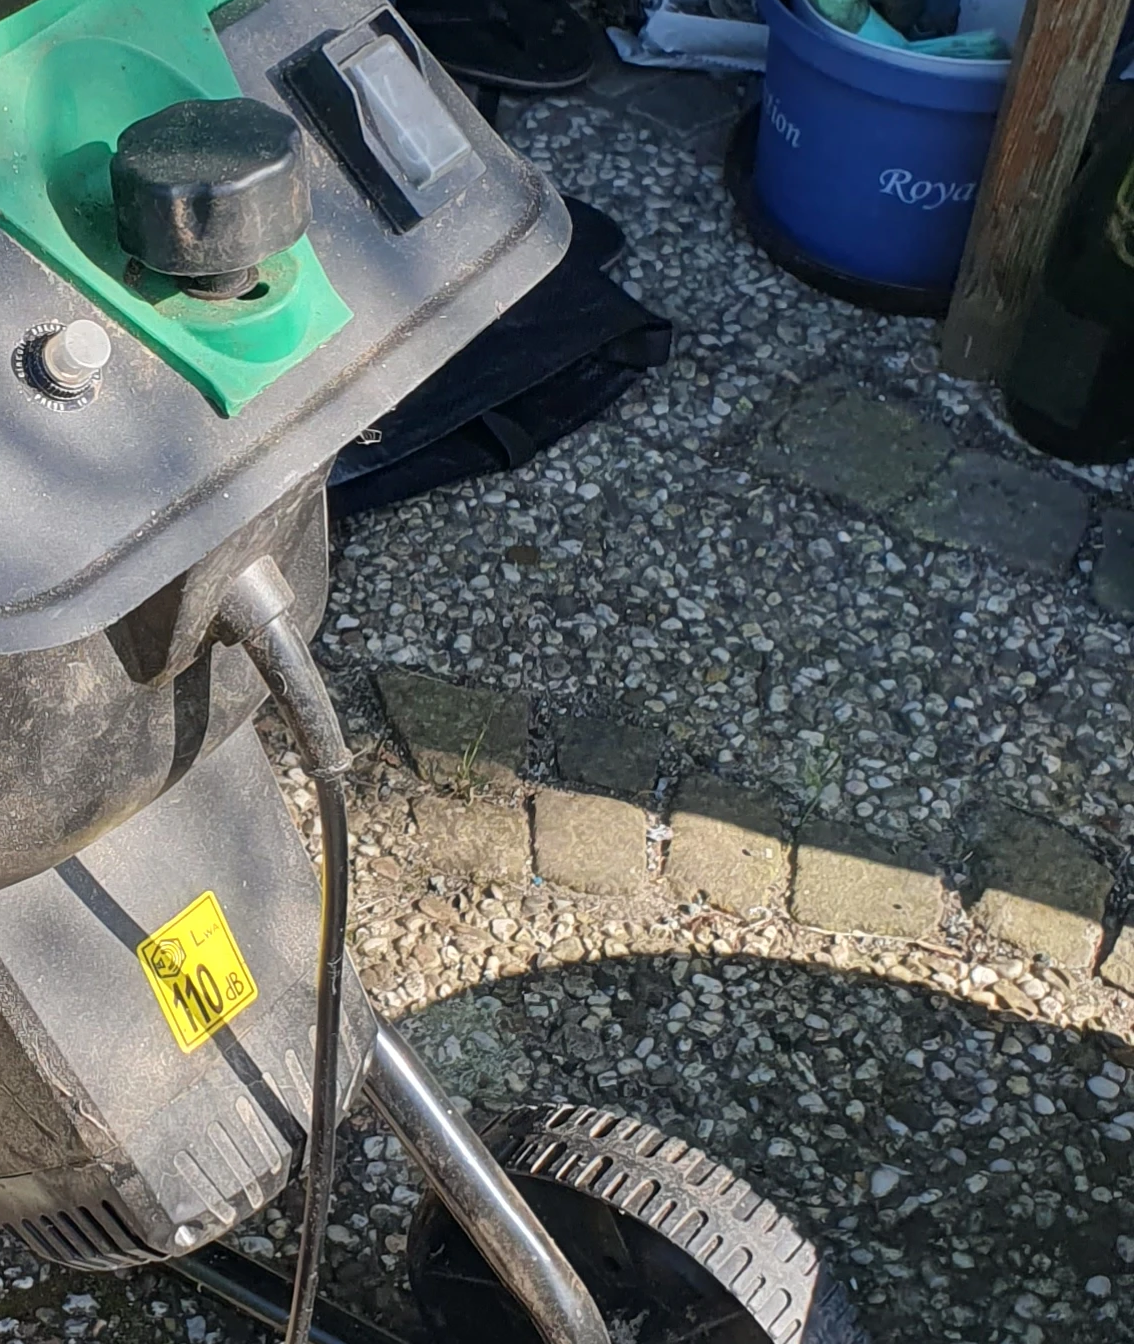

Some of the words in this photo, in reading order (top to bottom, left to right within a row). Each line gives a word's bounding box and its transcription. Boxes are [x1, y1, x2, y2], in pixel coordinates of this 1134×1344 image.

[879, 168, 976, 210] Roya
[172, 963, 224, 1033] 110
[225, 971, 245, 1001] dB
